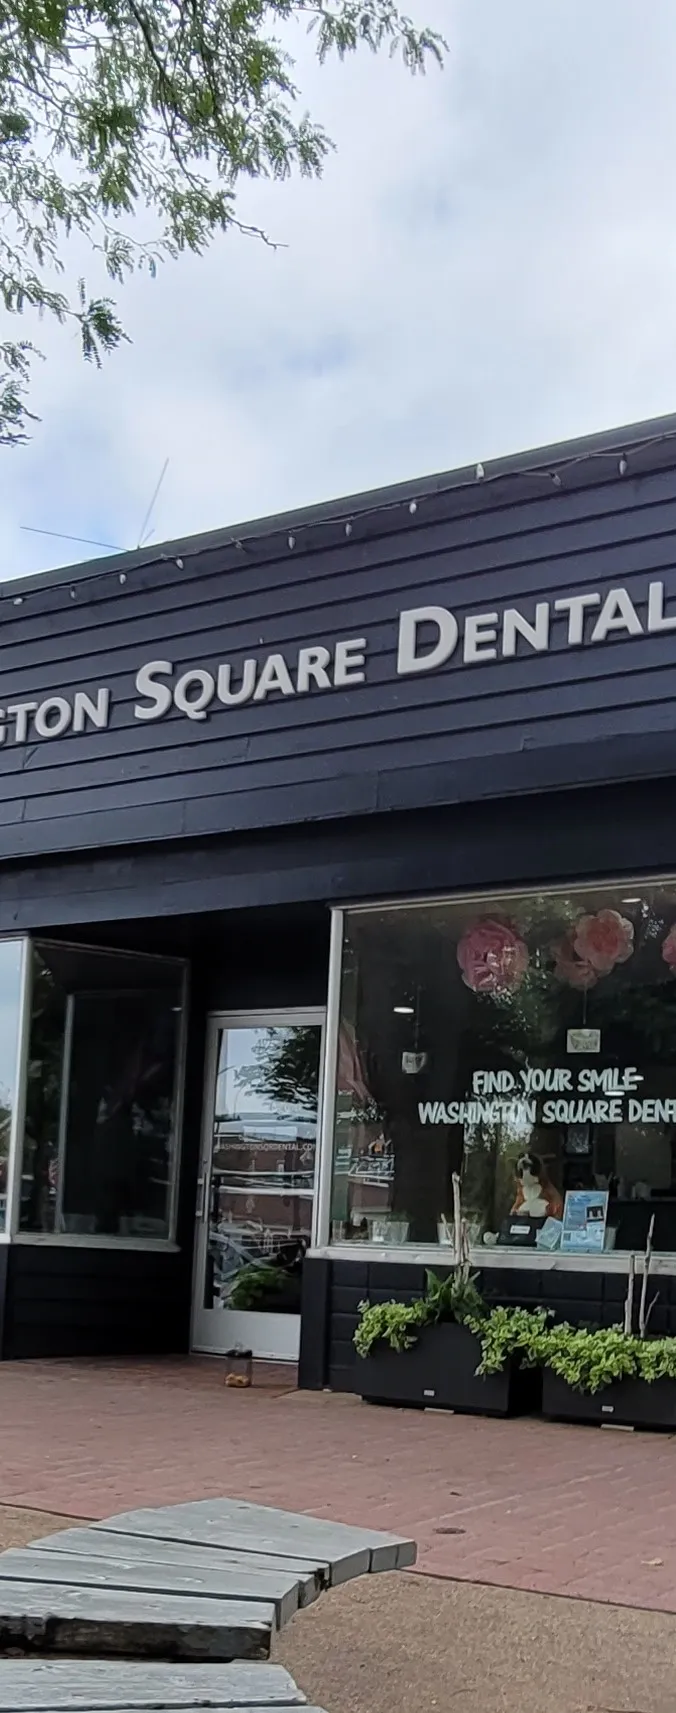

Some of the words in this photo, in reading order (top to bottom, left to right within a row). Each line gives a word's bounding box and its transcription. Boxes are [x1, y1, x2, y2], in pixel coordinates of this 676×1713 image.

[0, 688, 110, 744] TON
[135, 638, 367, 719] SQUARE
[396, 581, 676, 676] DENTAL
[472, 1069, 515, 1094] FIND
[519, 1068, 573, 1092] YOUR
[577, 1067, 638, 1092] SMILE
[418, 1100, 537, 1124] WASHINGTON
[542, 1099, 623, 1124] SQUARE
